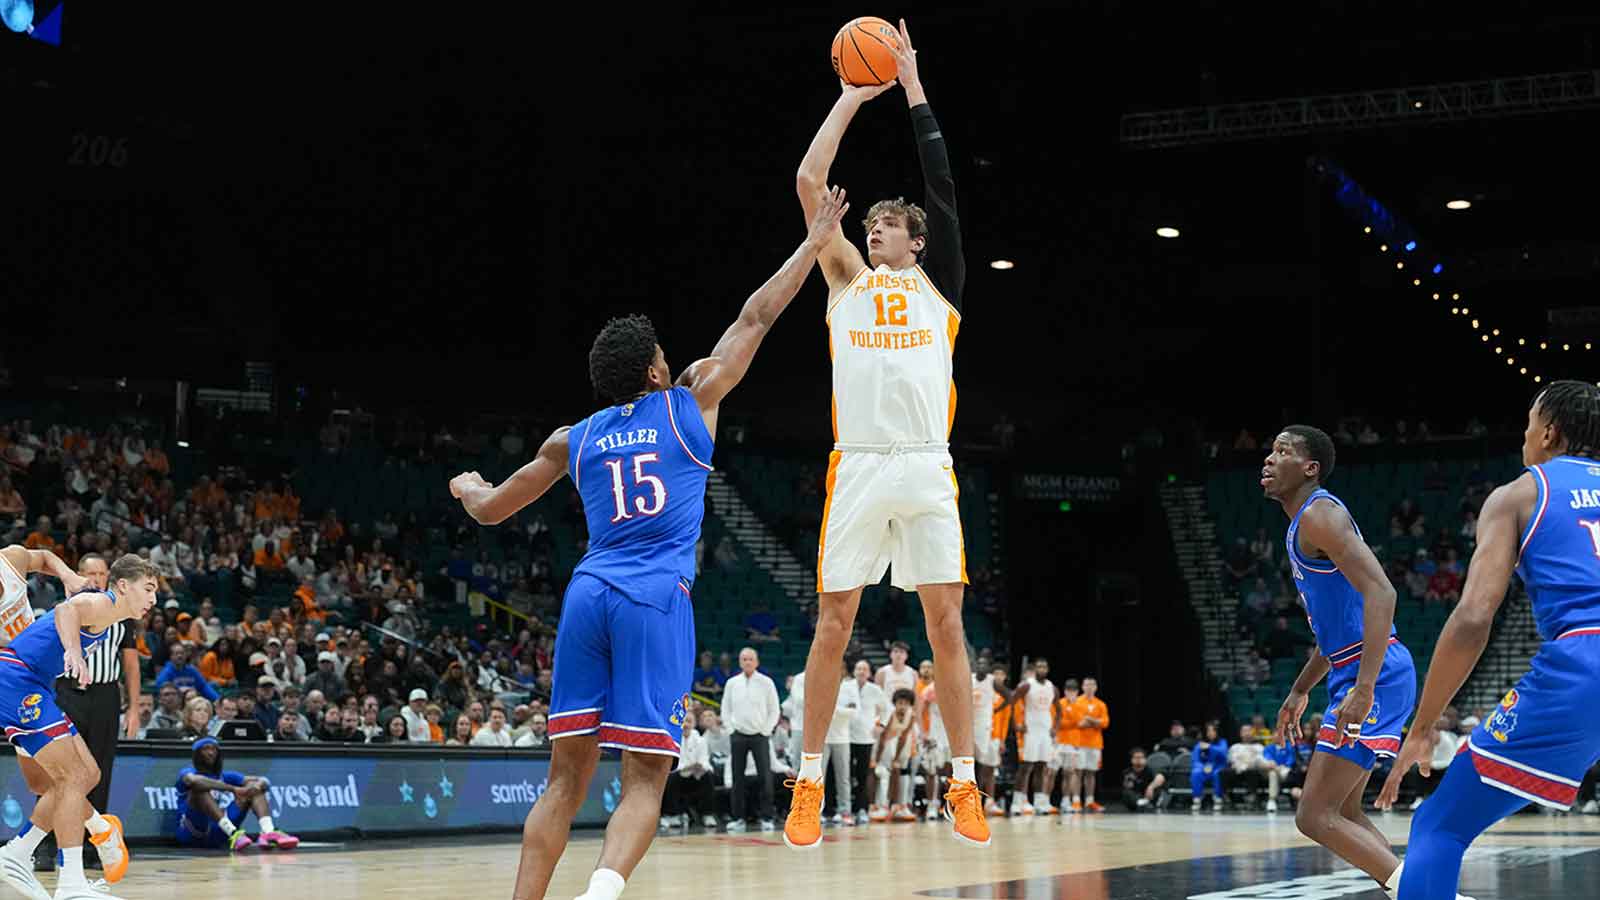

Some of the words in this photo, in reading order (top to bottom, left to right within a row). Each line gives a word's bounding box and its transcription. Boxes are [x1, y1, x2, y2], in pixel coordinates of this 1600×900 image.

[68, 134, 129, 168] 206
[873, 292, 908, 327] 12
[848, 328, 934, 350] VOLUNTEERS
[596, 429, 658, 453] TILLER
[604, 453, 667, 523] 15
[1569, 488, 1600, 510] JAC
[313, 773, 360, 808] and
[490, 779, 537, 803] sam's
